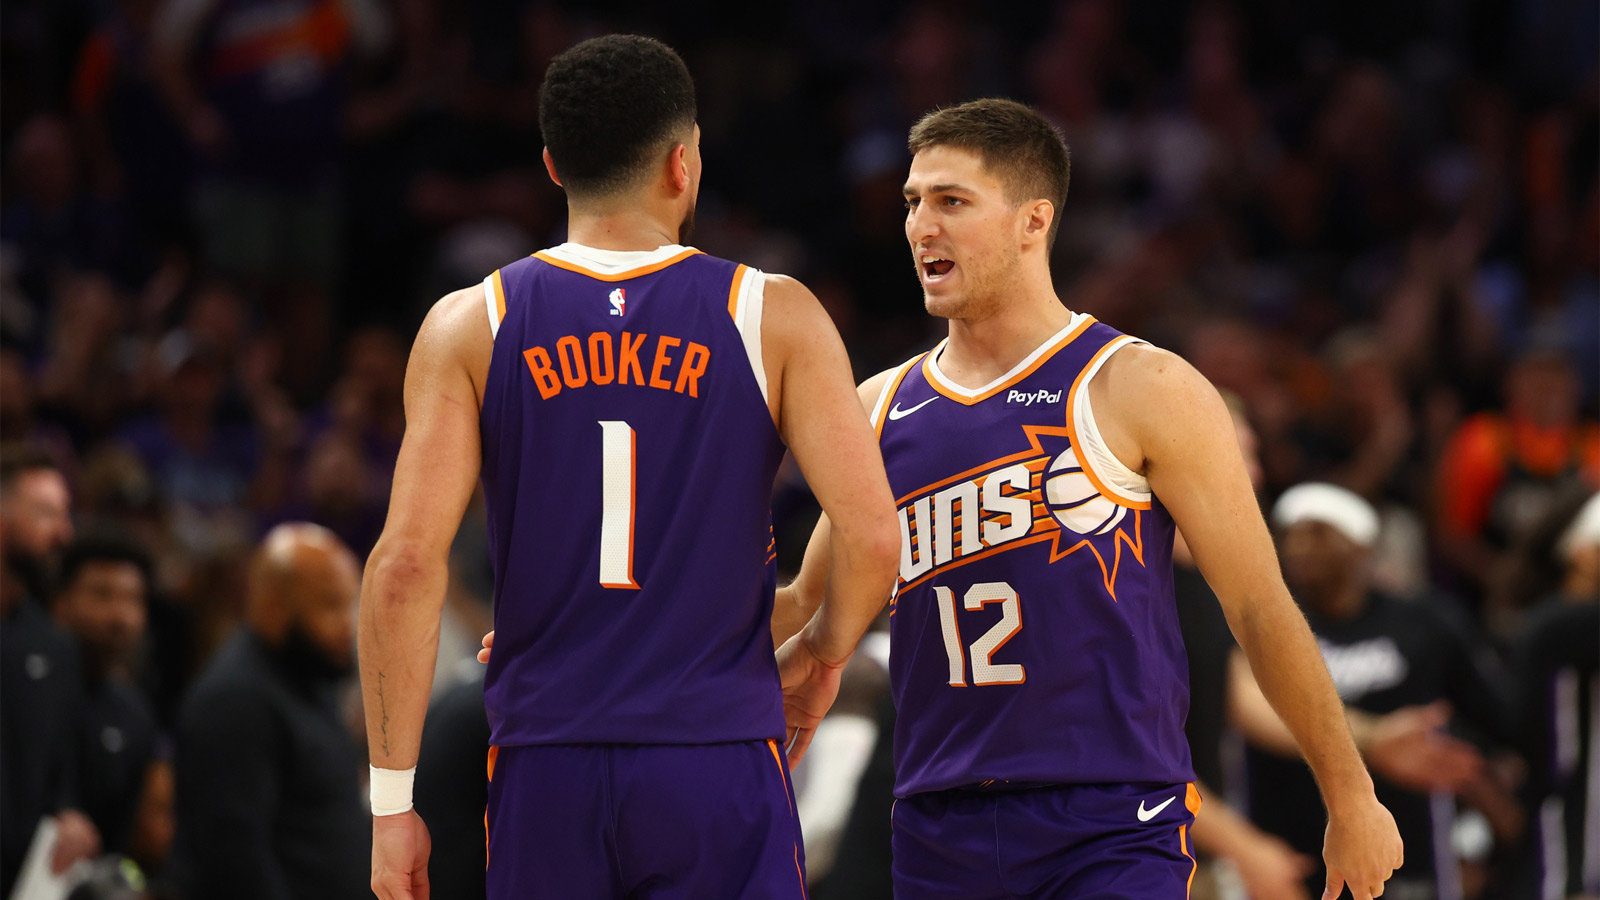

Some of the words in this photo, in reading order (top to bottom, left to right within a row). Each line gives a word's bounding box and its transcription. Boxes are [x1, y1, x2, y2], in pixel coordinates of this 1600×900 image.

[522, 331, 711, 400] BOOKER
[1006, 389, 1062, 407] PayPal
[597, 420, 642, 590] 1
[932, 581, 1026, 687] 12
